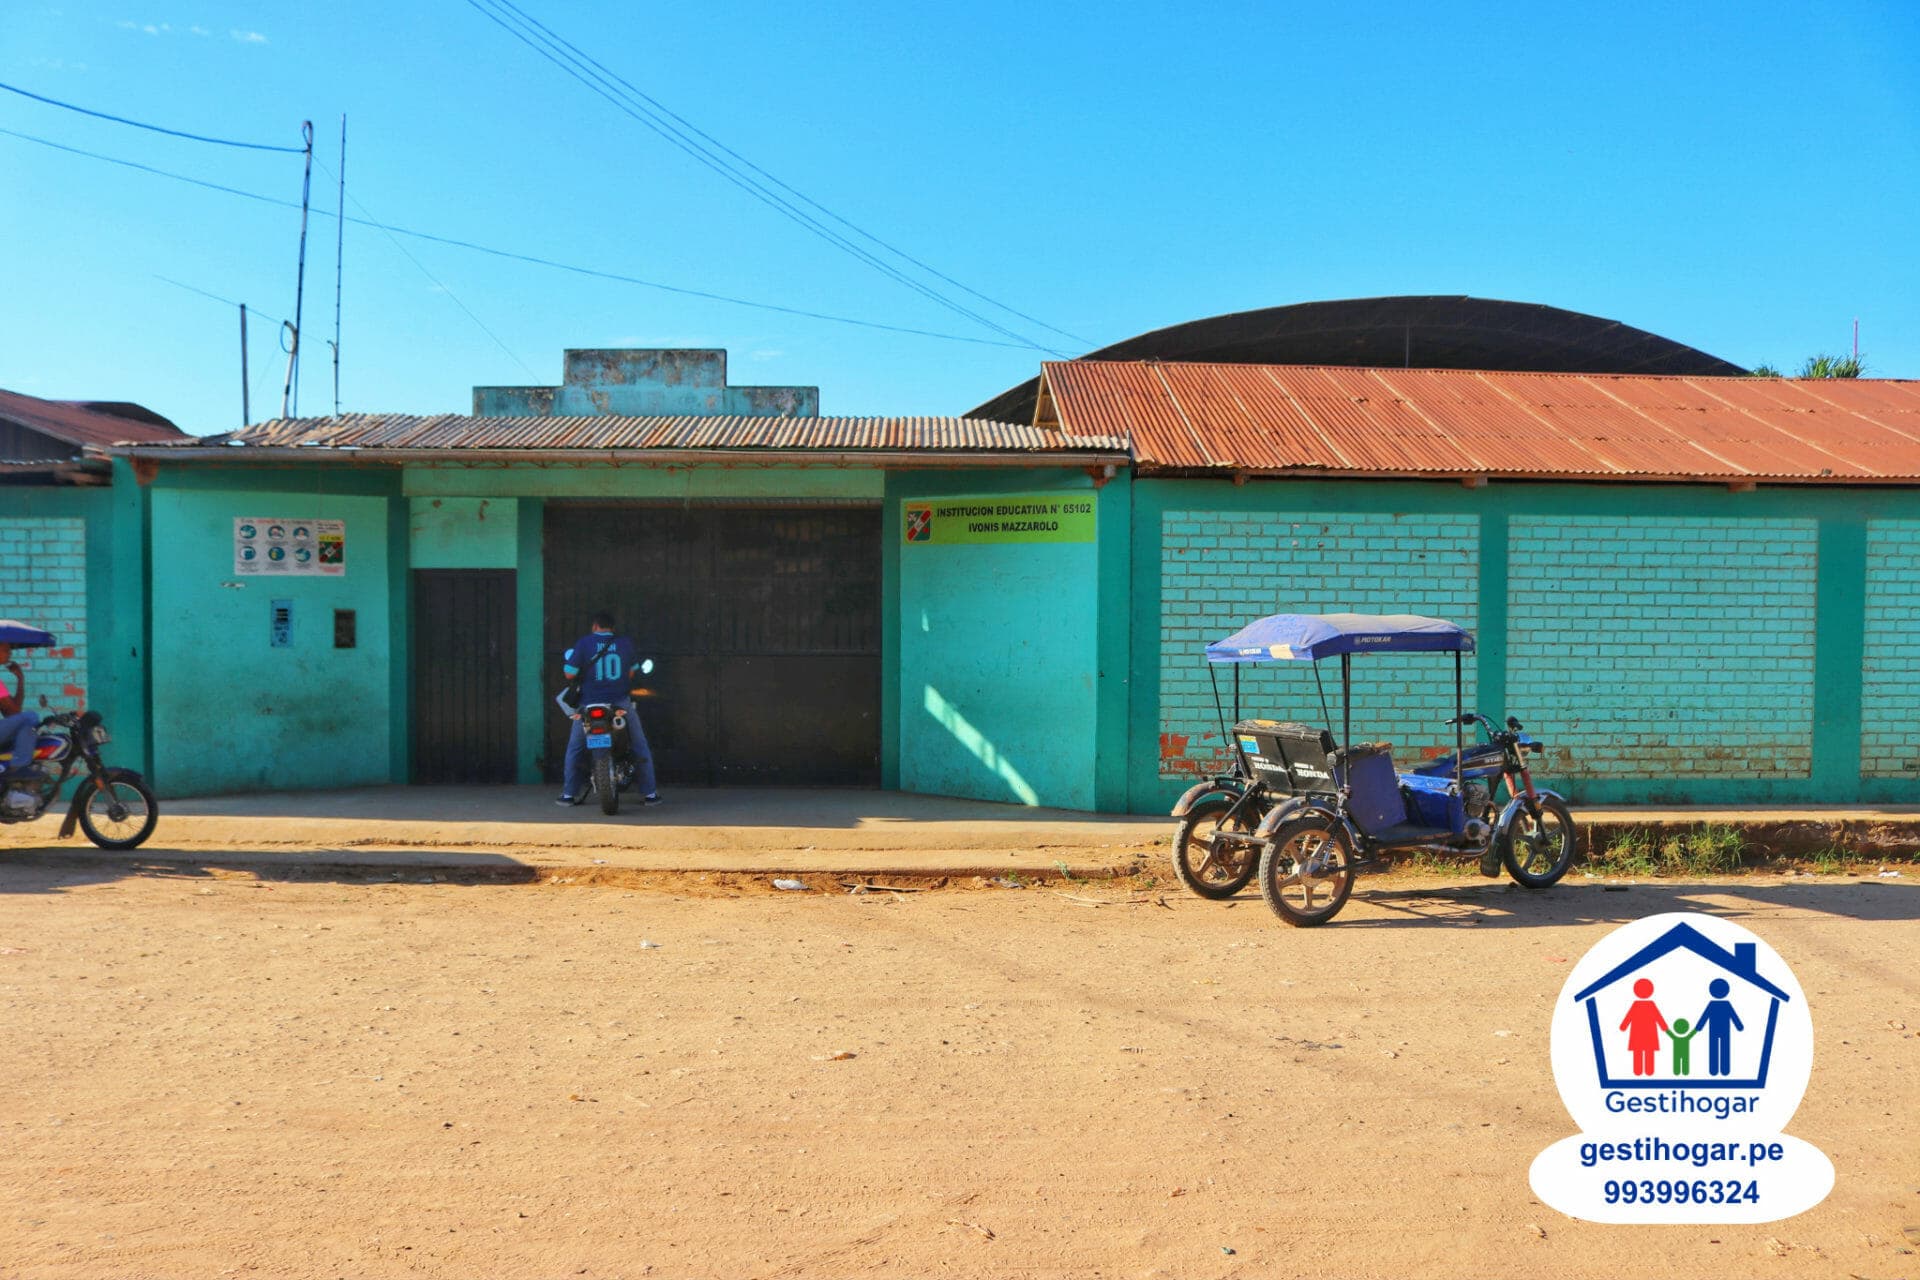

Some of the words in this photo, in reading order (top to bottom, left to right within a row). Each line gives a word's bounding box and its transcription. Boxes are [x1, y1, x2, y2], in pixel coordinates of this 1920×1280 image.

[937, 507, 993, 517] INSTITUCION
[996, 505, 1048, 516] EDUCATIVA
[1063, 504, 1091, 514] 65102
[968, 522, 999, 533] IVONIS
[1001, 521, 1059, 532] MAZZAROLO
[1361, 636, 1392, 644] MOTOKAR
[595, 652, 621, 681] 10
[1253, 762, 1287, 773] HONDA
[1296, 768, 1331, 779] HONDA
